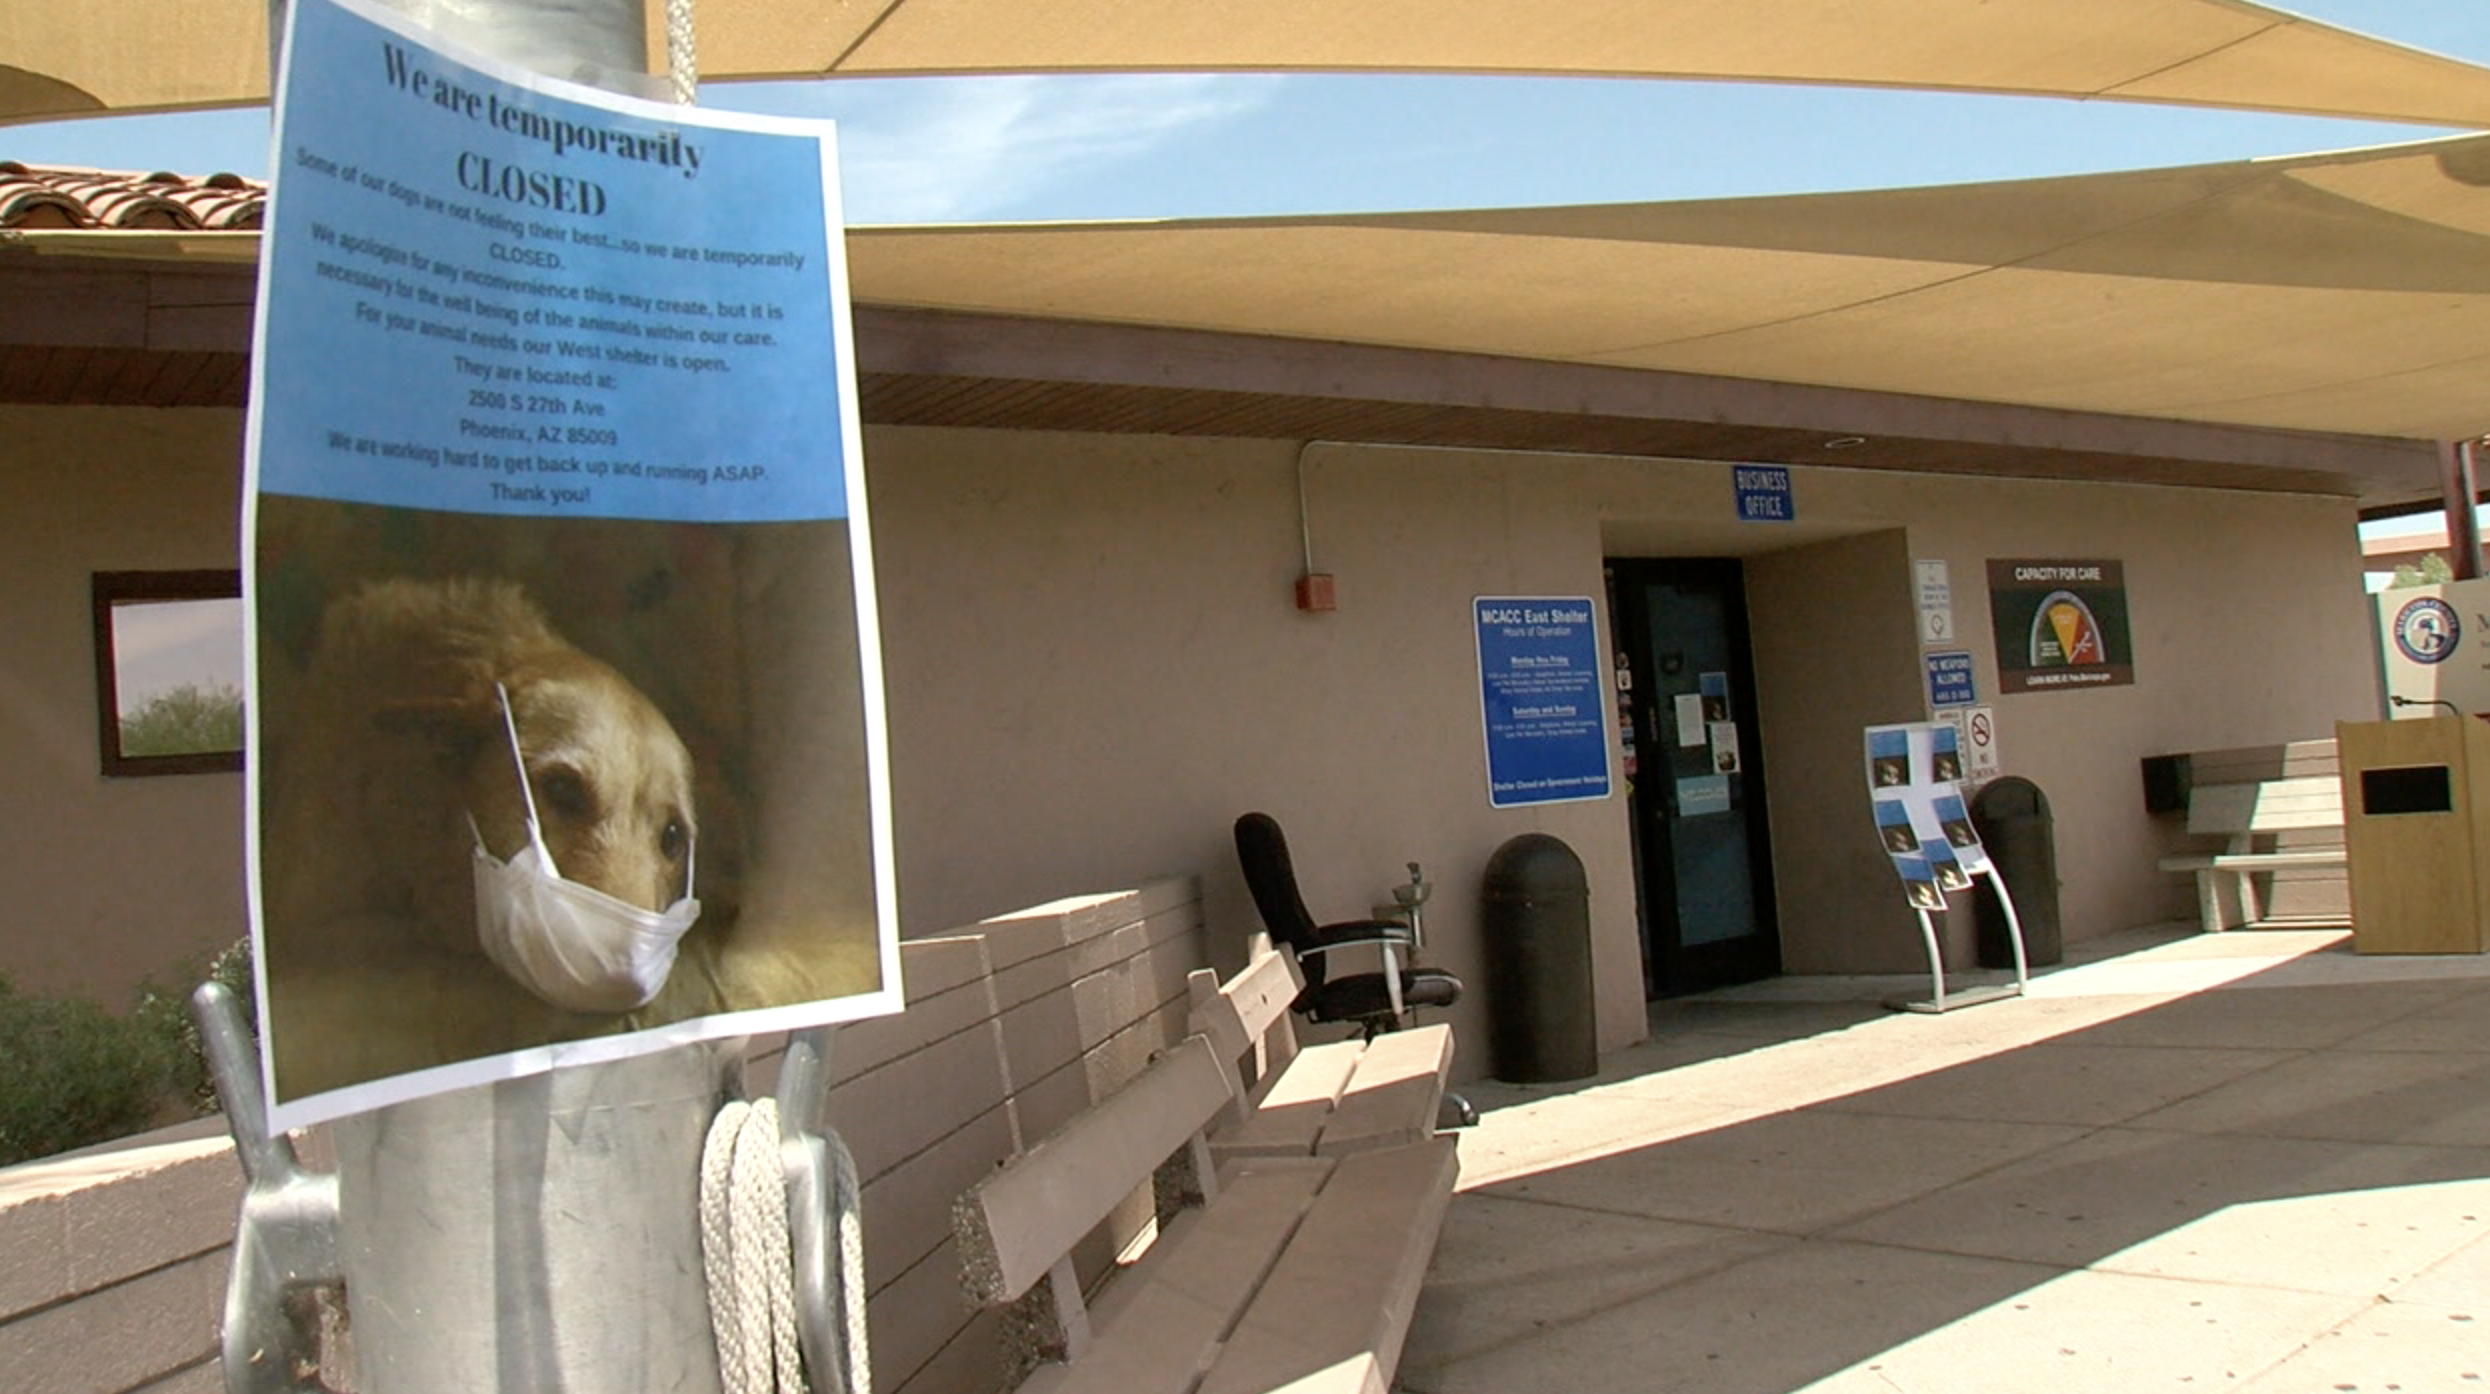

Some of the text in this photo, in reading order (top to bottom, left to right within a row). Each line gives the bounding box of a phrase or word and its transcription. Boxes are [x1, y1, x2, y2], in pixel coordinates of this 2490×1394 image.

[382, 42, 704, 180] We are temporarily
[457, 150, 607, 217] CLOSED
[297, 146, 338, 178] Some
[341, 166, 357, 183] of
[361, 172, 386, 192] our
[388, 180, 420, 207] dogs
[424, 194, 444, 213] are
[448, 202, 471, 221] not
[474, 207, 524, 239] feeling
[528, 222, 566, 243] their
[645, 243, 668, 256] we
[672, 246, 699, 261] are
[703, 248, 805, 271] temporarily
[489, 241, 566, 270] CLOSED.
[311, 221, 335, 245] We
[411, 250, 430, 270] for
[433, 260, 459, 282] any
[462, 268, 579, 300] inconvenience
[584, 284, 614, 304] this
[619, 292, 651, 312] may
[656, 298, 713, 318] create,
[717, 302, 746, 318] but
[751, 303, 763, 319] it
[768, 304, 784, 320] is
[317, 260, 778, 346] necessary for the well being of the animals within our care.
[356, 301, 730, 373] For your animal needs our West shelter is open.
[454, 356, 617, 389] They are located at:
[511, 395, 523, 411] S
[528, 396, 566, 414] 27th
[573, 400, 606, 416] Ave
[460, 419, 618, 446] Phoenix, AZ 85009
[327, 431, 351, 451] We
[356, 438, 377, 456] are
[381, 440, 440, 468] working
[444, 448, 478, 467] hard
[483, 454, 499, 469] to
[504, 456, 532, 474] get
[537, 455, 580, 473] back
[586, 460, 608, 478] up
[613, 460, 640, 477] and
[646, 464, 707, 485] running
[490, 483, 591, 505] Thank you!
[1737, 470, 1787, 491] BUSINESS
[1745, 496, 1782, 516] OFFICE
[2015, 567, 2101, 580] CAPACITY FOR CARE
[1481, 608, 1588, 624] MCACC East Shelter
[1503, 626, 1571, 639] Hours of Operation
